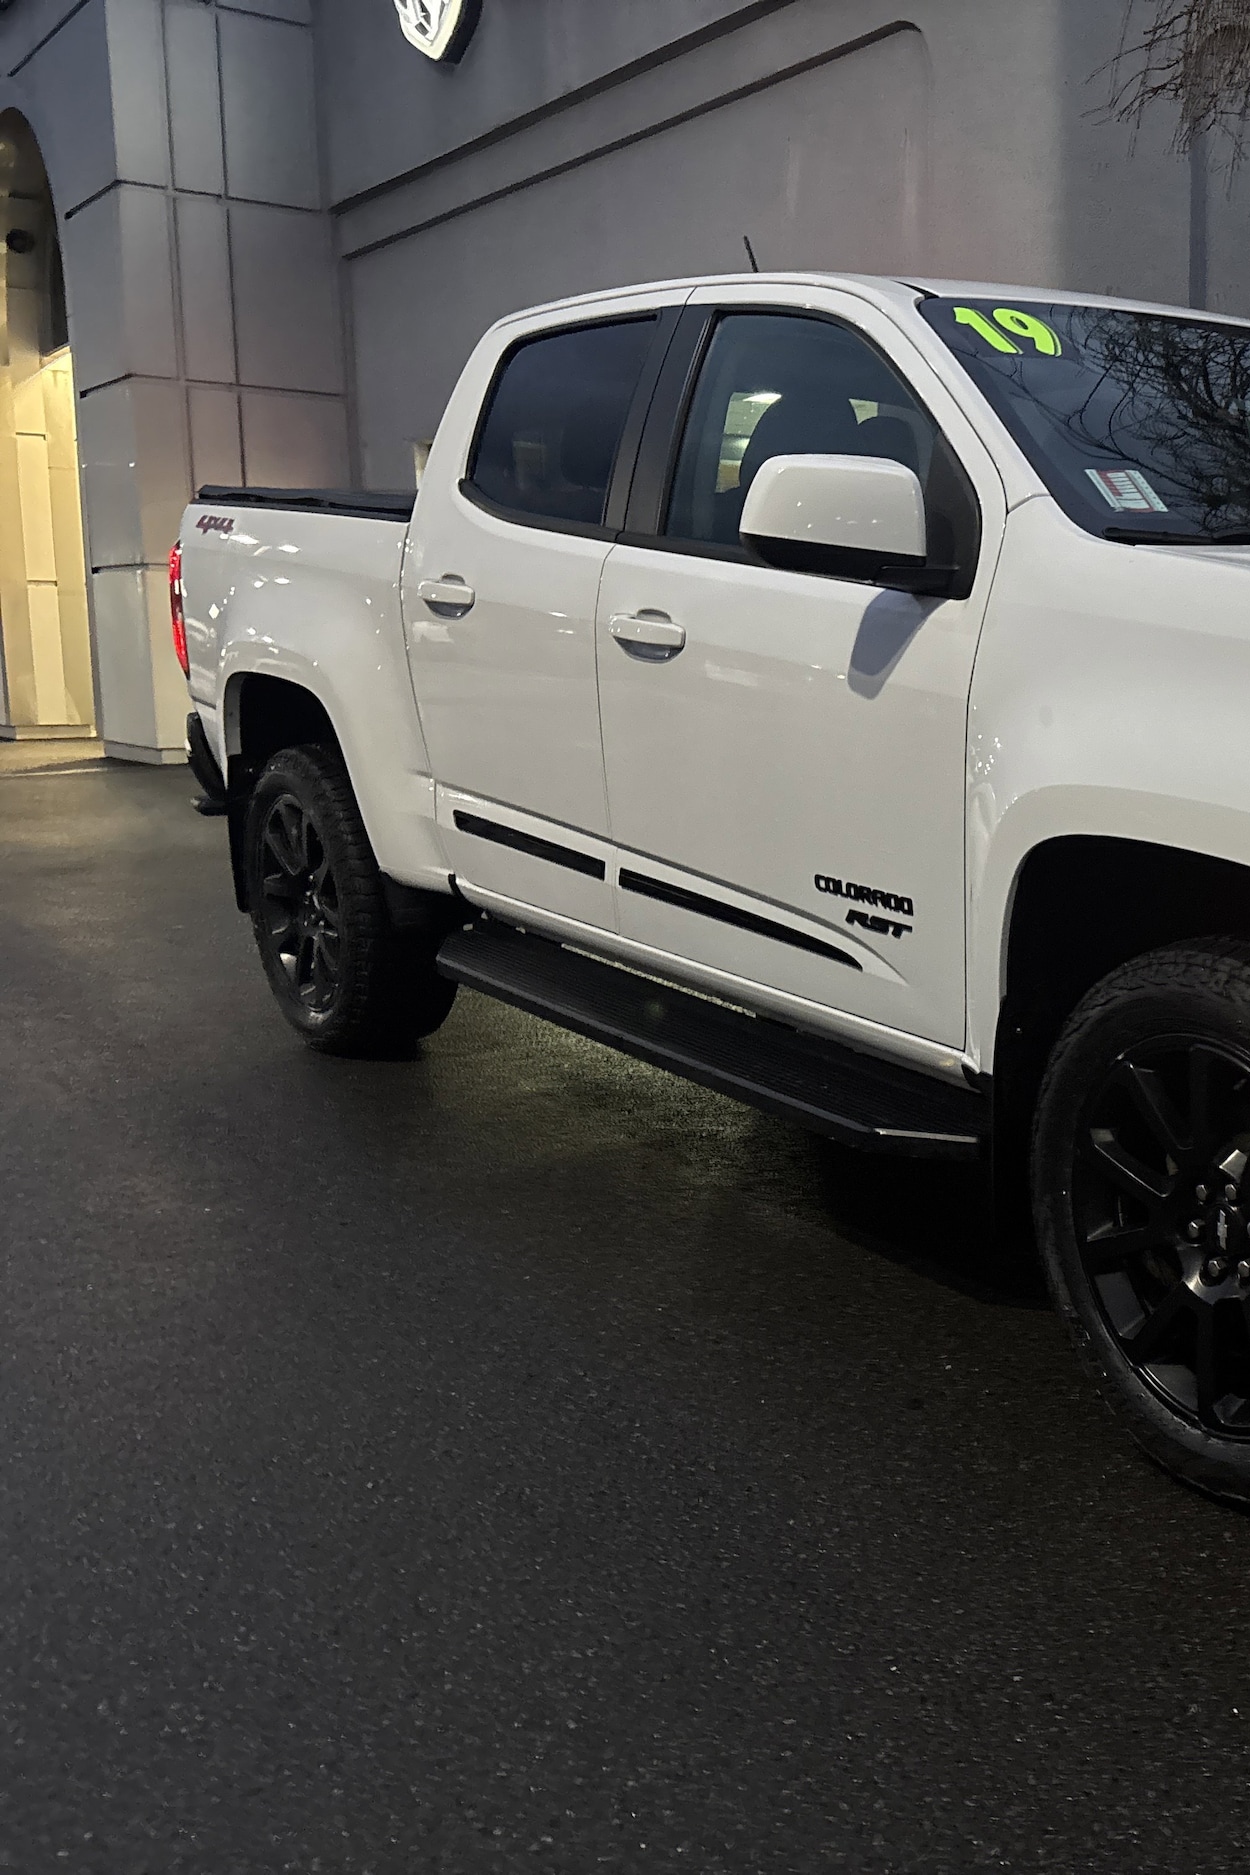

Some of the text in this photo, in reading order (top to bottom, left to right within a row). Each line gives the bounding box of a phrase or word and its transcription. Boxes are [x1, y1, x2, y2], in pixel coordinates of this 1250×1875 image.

[953, 306, 1062, 357] 19
[813, 874, 914, 917] COLORADO
[845, 909, 913, 940] RST
